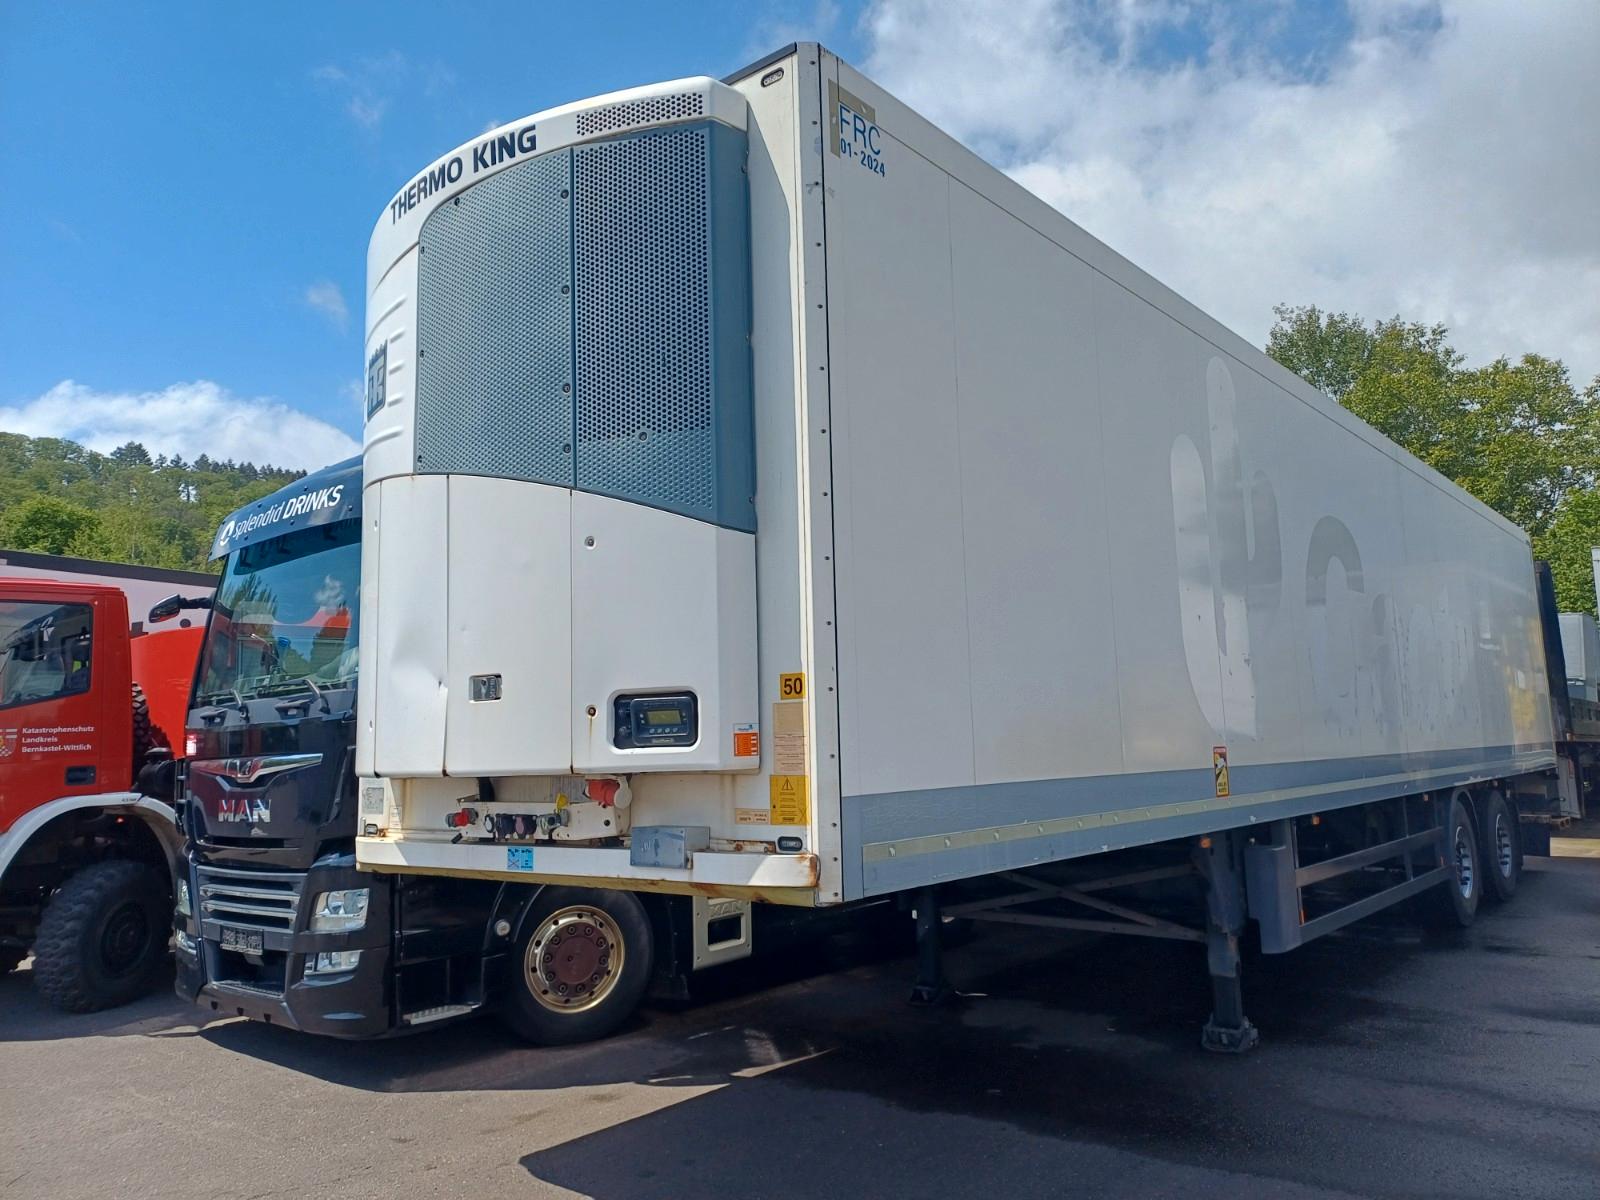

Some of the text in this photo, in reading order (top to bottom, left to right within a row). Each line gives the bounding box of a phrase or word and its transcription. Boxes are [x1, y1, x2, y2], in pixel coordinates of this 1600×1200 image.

[839, 104, 881, 156] FRC
[390, 124, 537, 225] THERMO KING
[233, 484, 345, 540] splendid DRINKS
[783, 677, 803, 696] 50
[22, 725, 95, 735] Katastrophenschutz
[22, 735, 58, 743] Landkreis
[22, 743, 92, 753] Bernkastel-Wittlich
[218, 799, 272, 823] MAN
